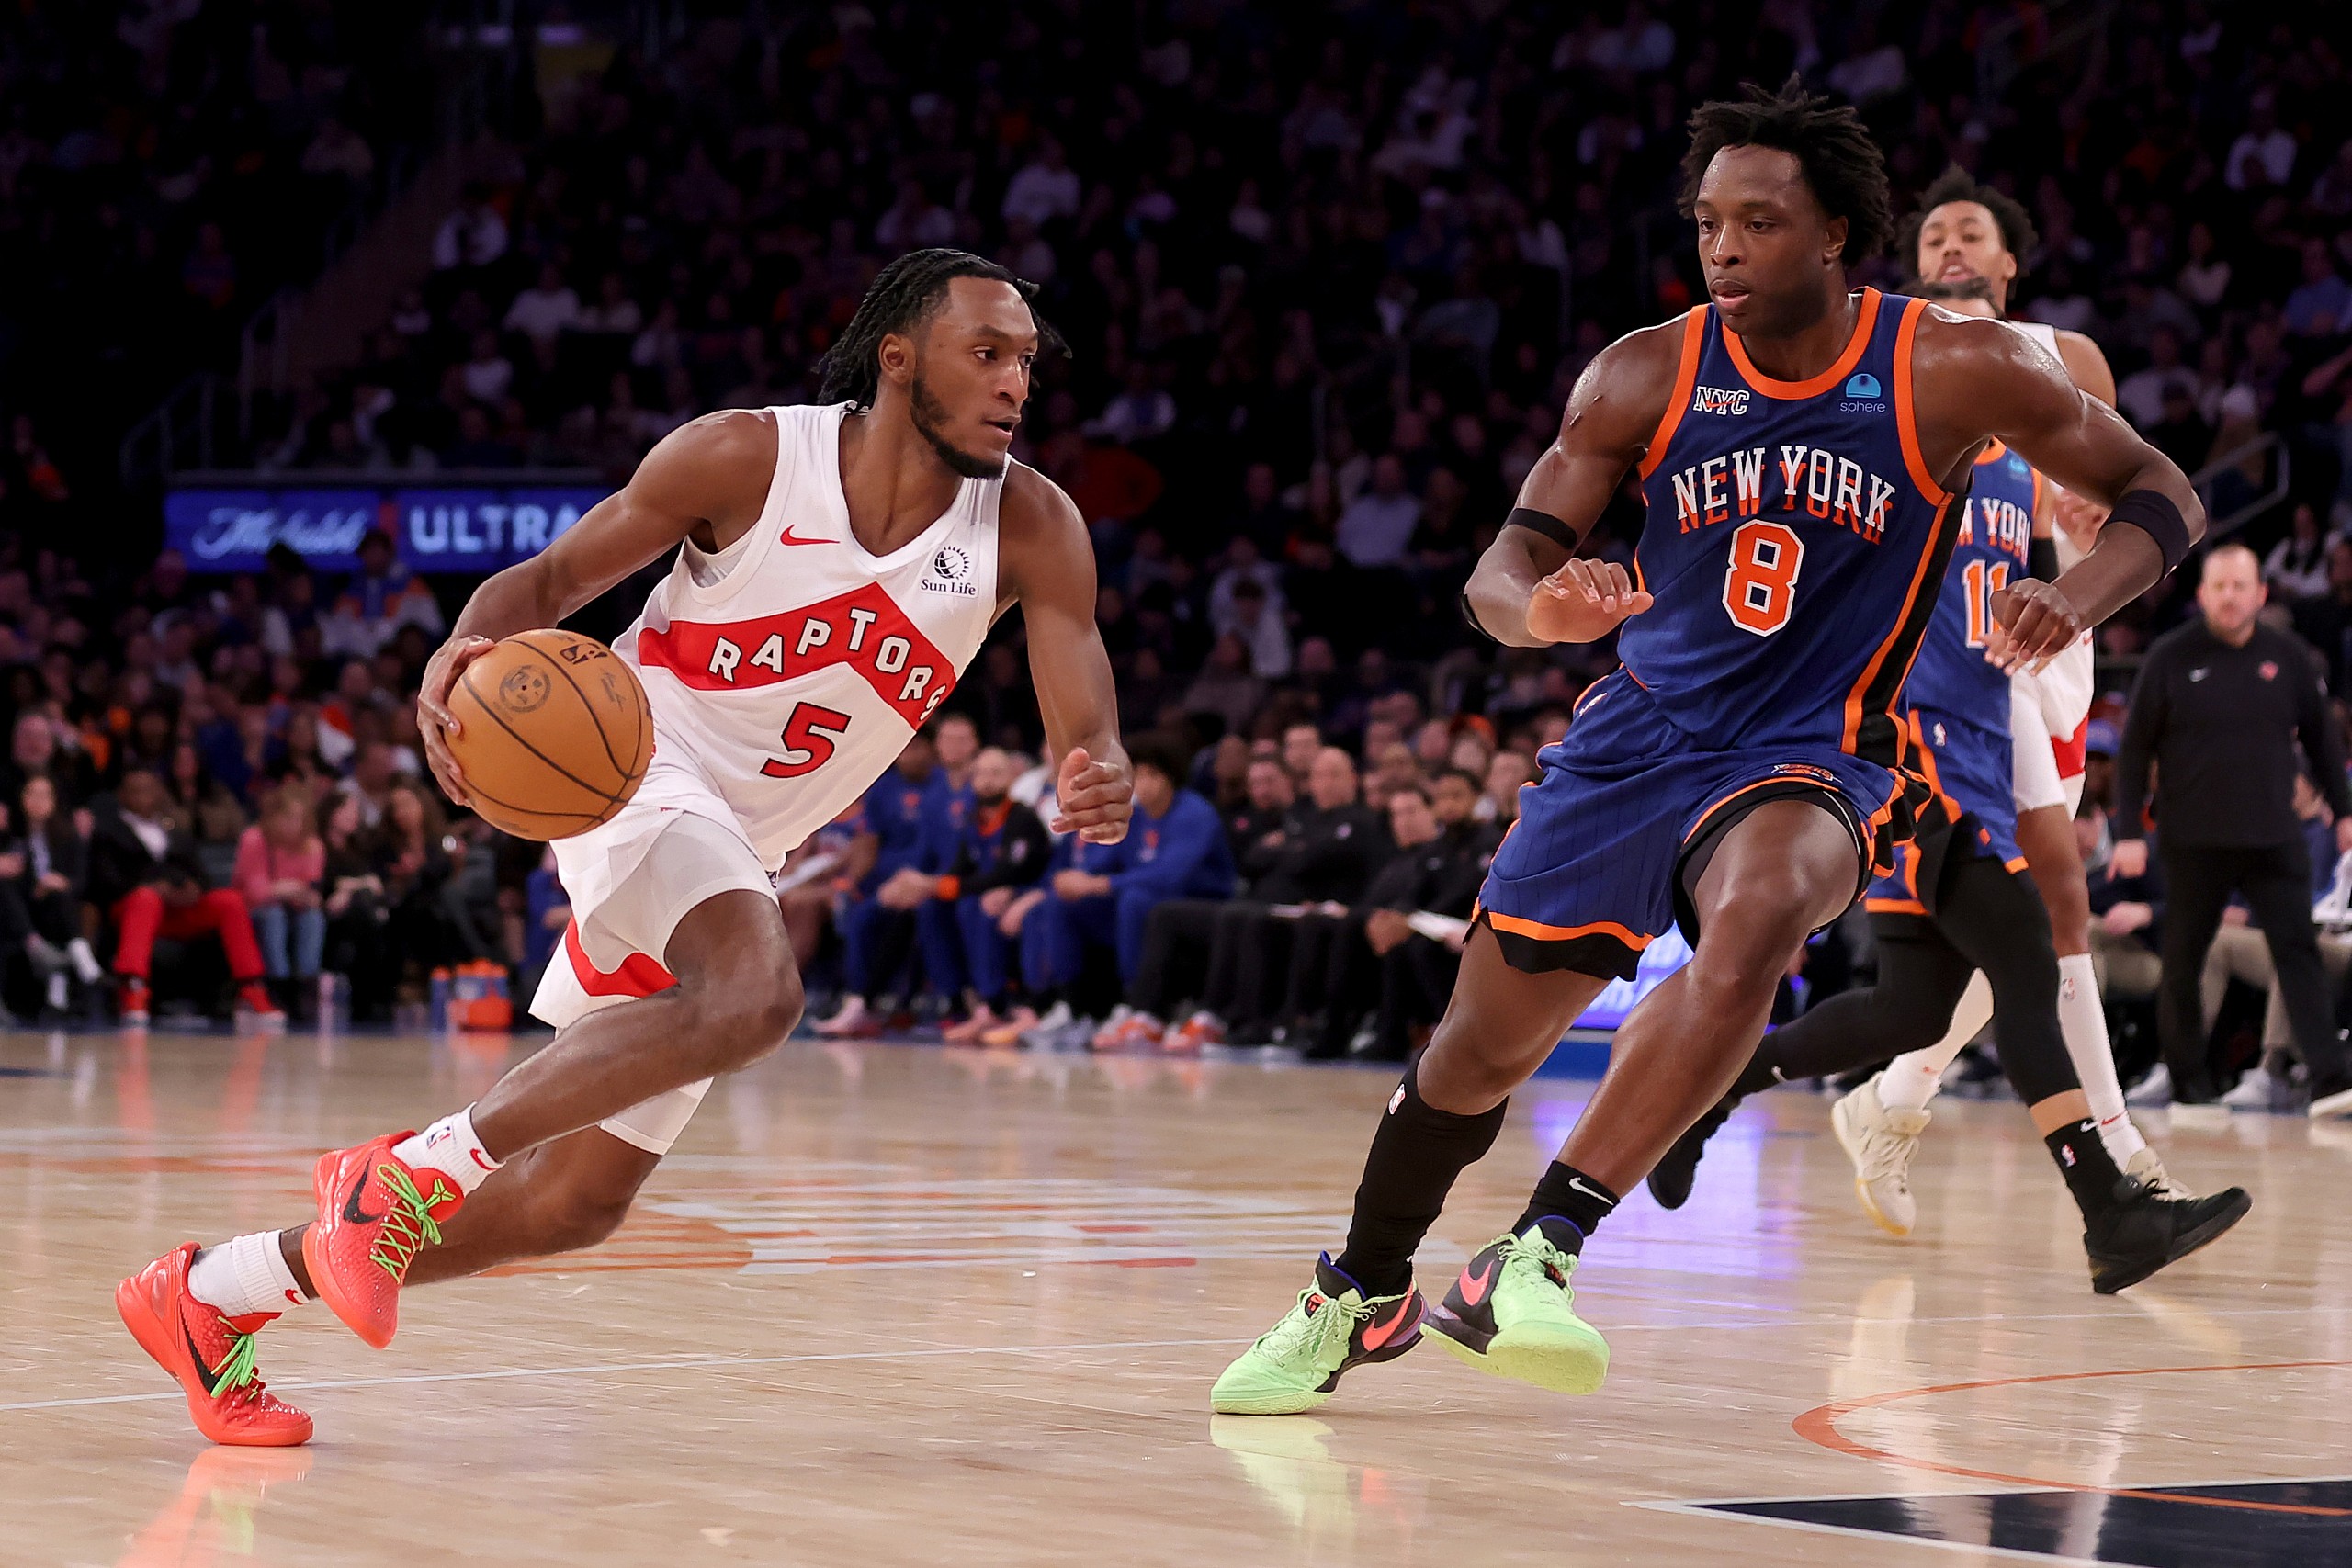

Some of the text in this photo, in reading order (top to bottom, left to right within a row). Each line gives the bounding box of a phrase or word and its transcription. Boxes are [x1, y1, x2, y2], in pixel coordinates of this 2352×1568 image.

[1692, 386, 1750, 415] NYC
[1839, 401, 1886, 413] sphere
[1671, 446, 1766, 534] NEW
[1779, 445, 1895, 544] YORK
[921, 578, 976, 596] Sun Life
[1722, 518, 1805, 637] 8
[1962, 558, 2010, 649] 11
[707, 607, 946, 721] RAPTORS
[759, 701, 853, 779] 5
